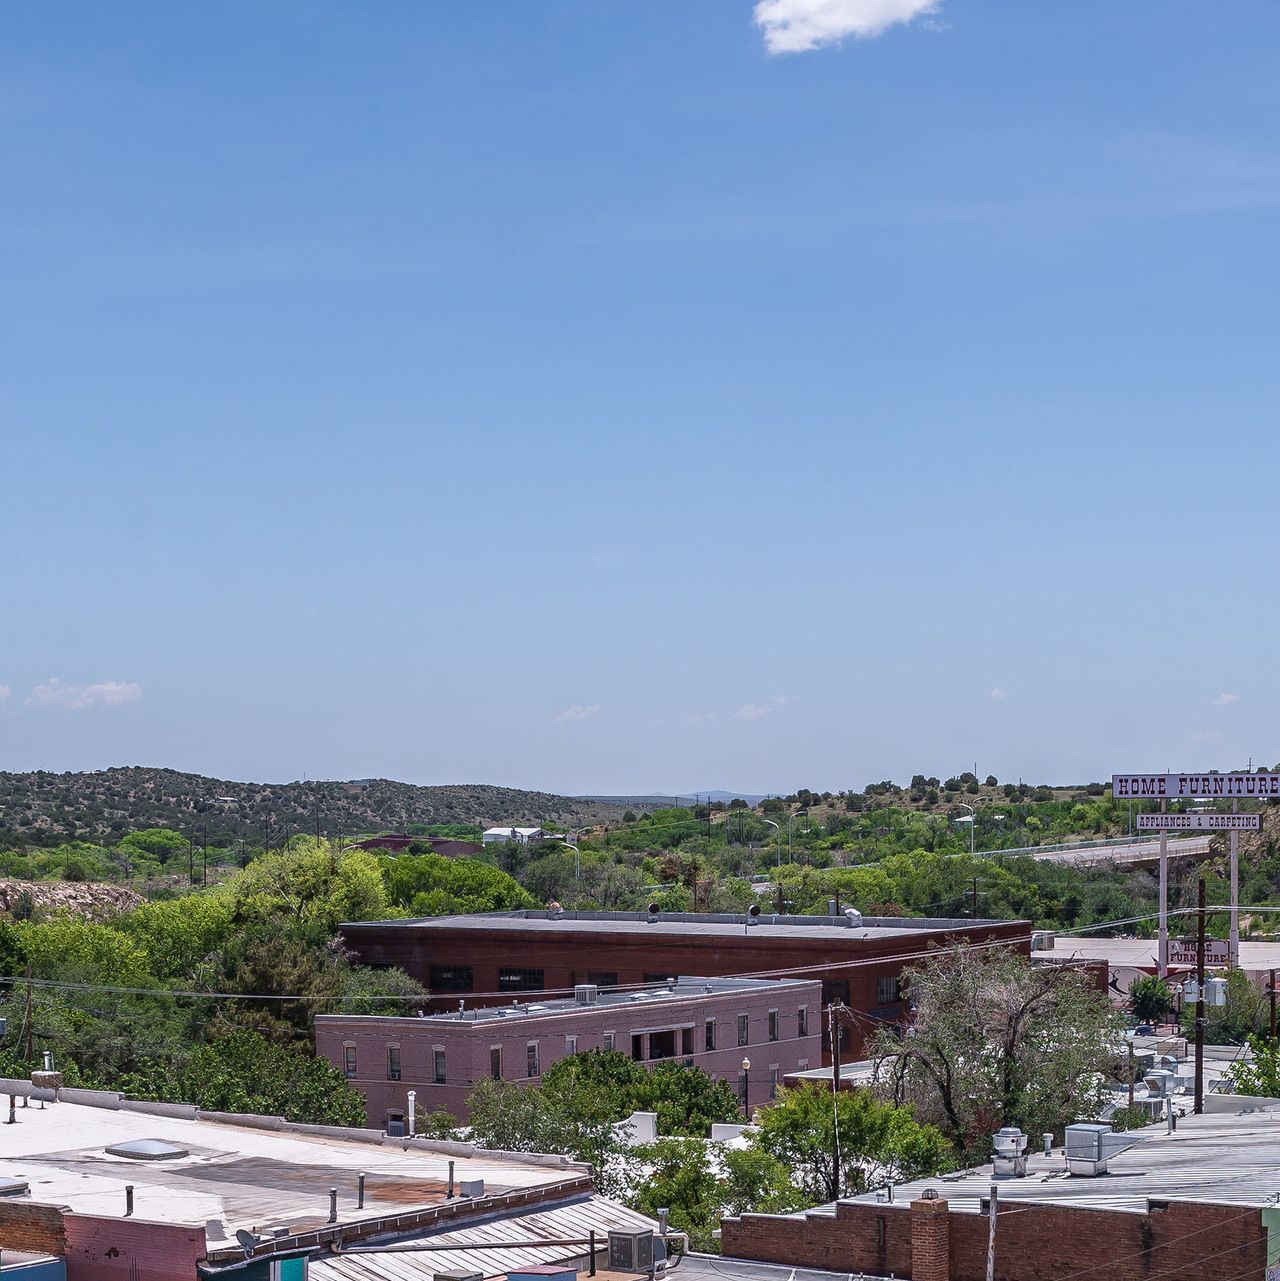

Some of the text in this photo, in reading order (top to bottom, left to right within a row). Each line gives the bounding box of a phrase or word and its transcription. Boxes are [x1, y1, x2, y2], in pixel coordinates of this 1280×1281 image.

[1118, 776, 1279, 795] HOME FURNITURE
[1139, 816, 1191, 827] APPLIANCES
[1209, 816, 1257, 828] CARPETING
[1184, 943, 1212, 952] HOE
